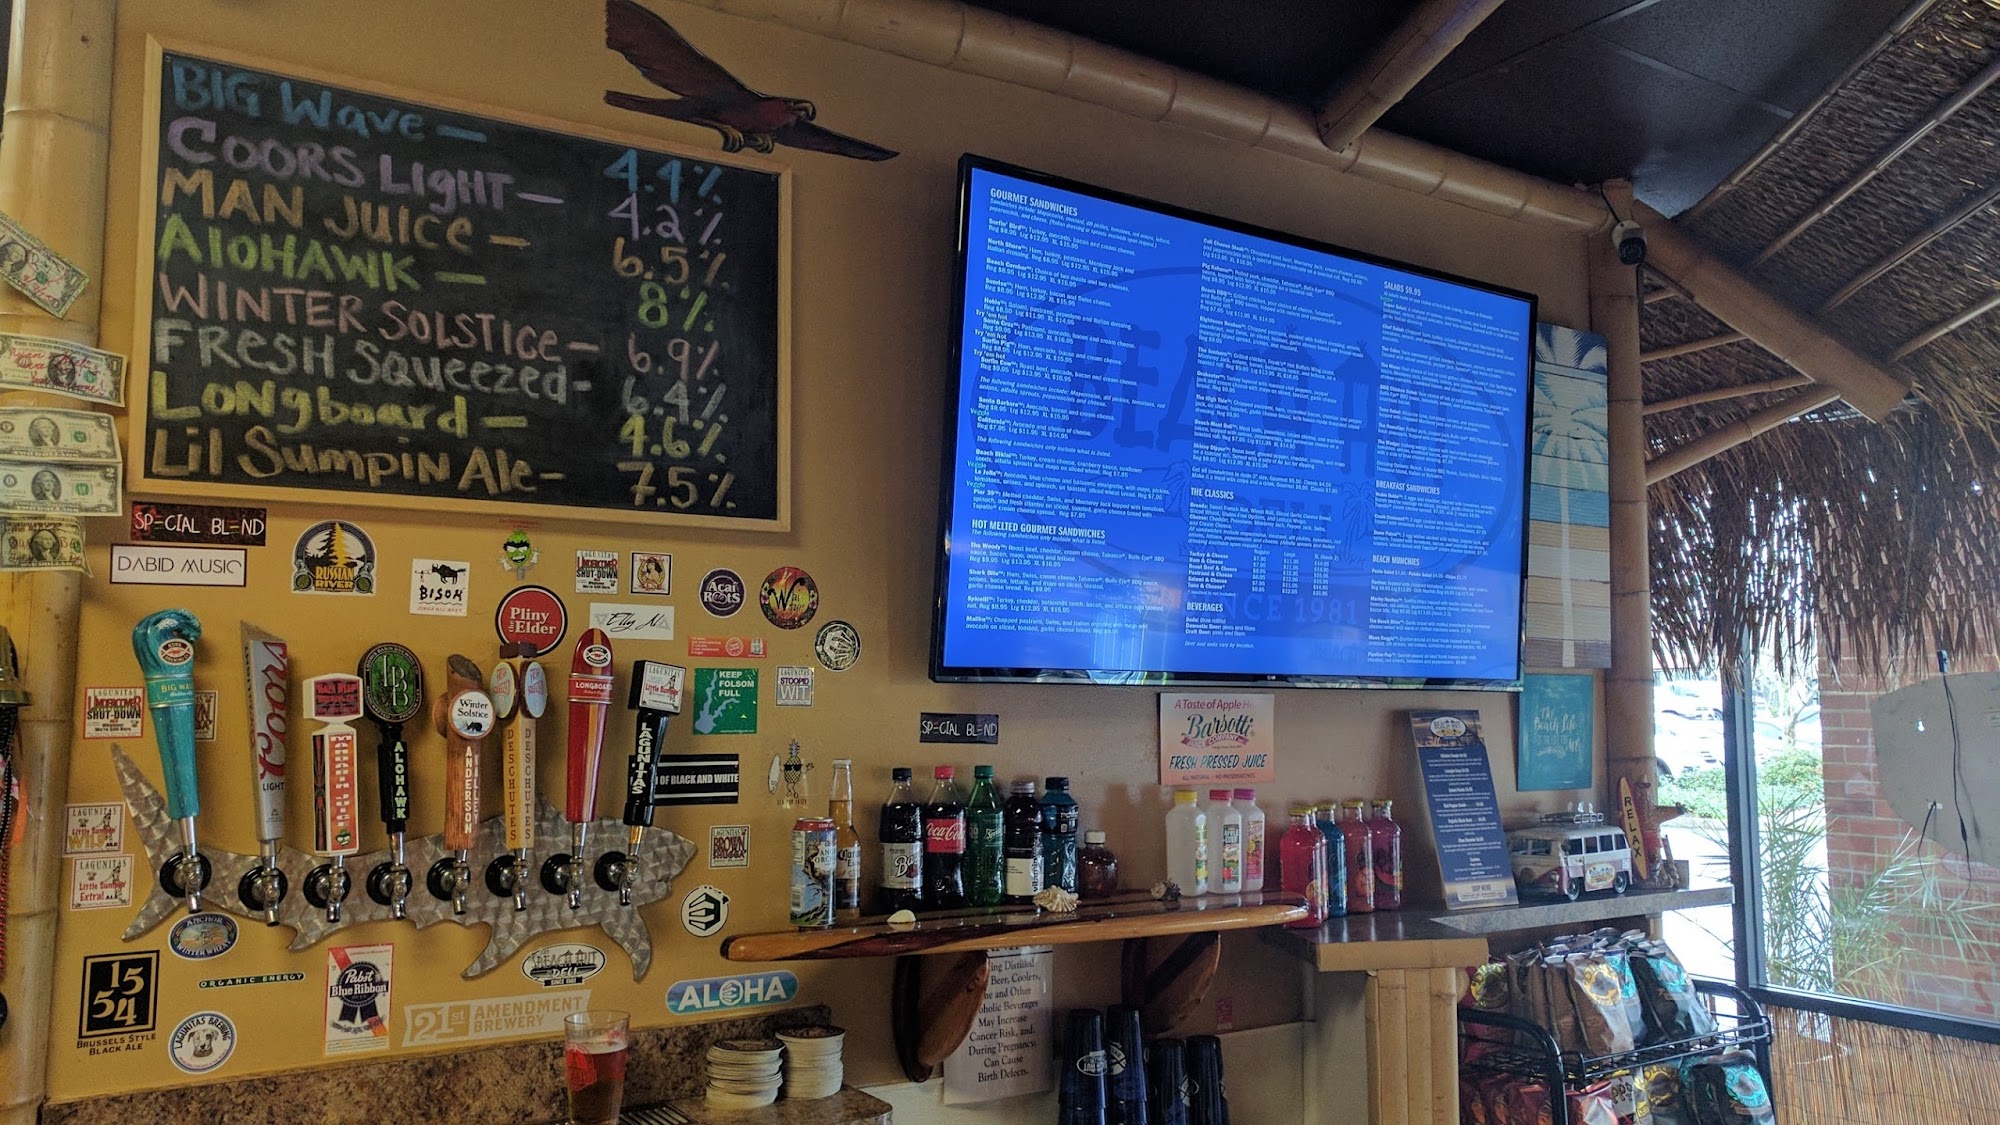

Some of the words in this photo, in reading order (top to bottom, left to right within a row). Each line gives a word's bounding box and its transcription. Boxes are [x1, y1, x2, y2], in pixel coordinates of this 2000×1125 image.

[171, 59, 263, 119] BIG
[280, 79, 425, 141] Wave
[161, 167, 303, 229] MAN
[990, 188, 1028, 204] GOURMET
[1029, 197, 1078, 216] SANDWICHES
[159, 272, 368, 335] WINTER
[152, 426, 223, 477] Lil
[616, 461, 737, 509] 7.5%
[1376, 480, 1405, 491] BREAKFAST
[1191, 487, 1203, 496] THE
[1204, 488, 1234, 500] CLASSICS
[972, 519, 987, 529] HOT
[989, 521, 1018, 532] MELTED
[1020, 524, 1057, 535] GOURMET
[1058, 526, 1105, 539] SANDWICHES
[181, 558, 242, 574] MUSIC
[316, 566, 354, 580] RUSSIAN
[314, 580, 354, 589] RIVER
[419, 585, 464, 601] BISON
[1186, 602, 1223, 612] BEVERAGES
[510, 607, 549, 624] Pliny
[515, 620, 556, 635] Elder
[161, 685, 176, 693] BIG
[719, 680, 754, 688] FOLSOM
[719, 689, 741, 697] FULL
[781, 685, 808, 700] WIT
[257, 641, 288, 780] Coors
[459, 698, 488, 709] Winter
[1175, 700, 1182, 709] A
[1183, 700, 1205, 709] Taste
[1206, 699, 1216, 709] of
[1216, 700, 1242, 711] Apple
[87, 710, 140, 720] SHUT-DOWN
[457, 708, 489, 719] Solstice
[1181, 713, 1254, 739] Barsotti
[632, 722, 653, 794] LAGUNITAS
[1169, 755, 1196, 770] FRESH
[1200, 754, 1239, 769] PRESSED
[1242, 754, 1267, 768] JUICE
[263, 782, 285, 791] LIGHT
[394, 741, 408, 819] ALOHAWK
[507, 729, 517, 841] DESCHUTES
[524, 728, 532, 840] DESCHUTES
[660, 775, 670, 784] OF
[671, 775, 696, 785] BLACK
[697, 774, 712, 784] AND
[714, 773, 739, 783] WHITE
[464, 746, 473, 834] ANDERSON
[1624, 796, 1642, 858] RELAX
[713, 837, 746, 851] BROWN
[79, 882, 98, 890] Little
[80, 892, 105, 901] Extra!
[175, 942, 206, 957] WINTER
[110, 961, 145, 996] 15
[345, 968, 374, 984] Pabst
[553, 966, 578, 977] DELI
[200, 976, 256, 988] ORGANIC
[262, 973, 303, 982] ENERGY
[991, 975, 1010, 985] Beer,
[331, 985, 353, 997] Blue
[354, 983, 387, 995] Ribbon
[677, 975, 787, 1011] ALOHA
[995, 990, 1008, 999] and
[1010, 986, 1031, 997] Other
[91, 988, 138, 1026] 54
[474, 996, 583, 1021] AMENDMENT
[1004, 999, 1038, 1011] Beverages
[474, 1014, 545, 1032] BREWERY
[978, 1017, 995, 1028] May
[998, 1014, 1027, 1025] Increase
[174, 1016, 206, 1050] LAGUNITAS
[207, 1017, 232, 1041] BREWING
[970, 1031, 996, 1042] Cancer
[1000, 1027, 1018, 1038] Risk,
[76, 1037, 125, 1049] BRUSSELS
[128, 1033, 157, 1043] STYLE
[89, 1046, 122, 1056] BLACK
[968, 1045, 996, 1056] During
[984, 1058, 999, 1068] Can
[1002, 1055, 1023, 1065] Cause
[978, 1071, 997, 1082] Birth
